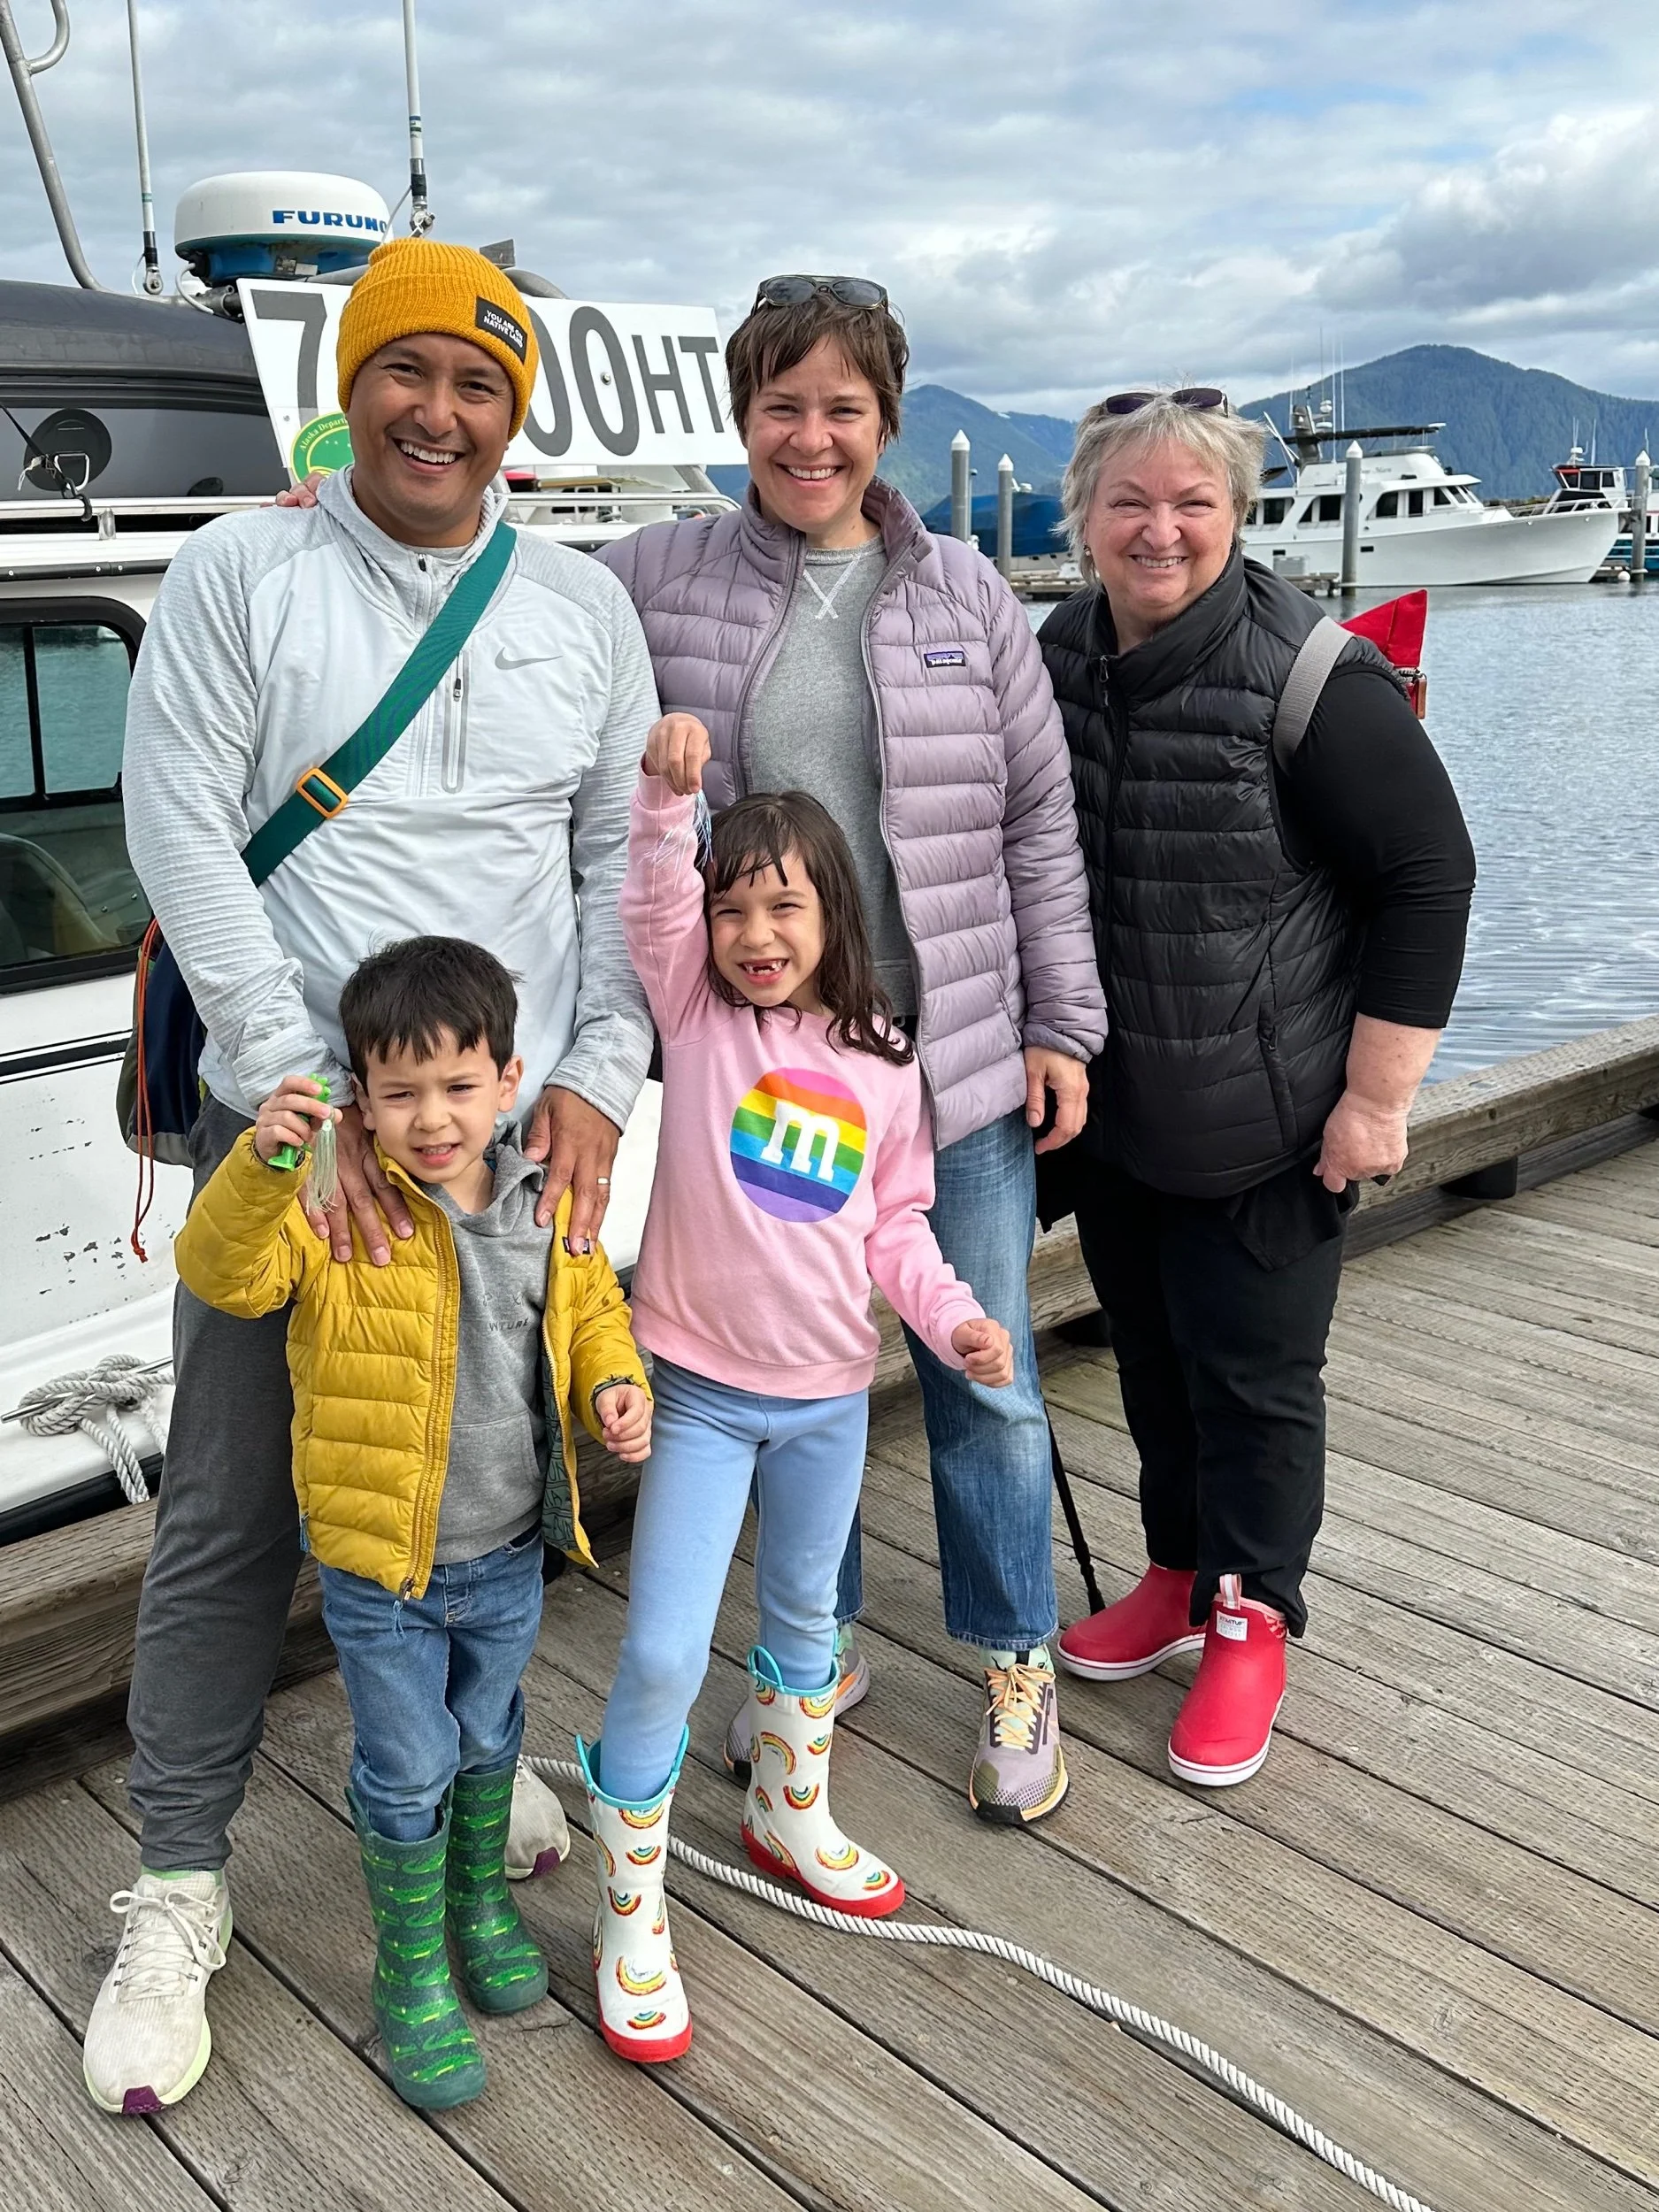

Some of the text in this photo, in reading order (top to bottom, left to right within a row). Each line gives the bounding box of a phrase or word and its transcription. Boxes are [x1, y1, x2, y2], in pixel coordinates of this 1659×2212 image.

[273, 210, 388, 234] FURUNO
[483, 315, 524, 348] NATIVE LAND
[486, 310, 503, 323] YOU
[503, 320, 515, 333] ARE
[300, 429, 319, 452] Alaska
[760, 1100, 841, 1183] m
